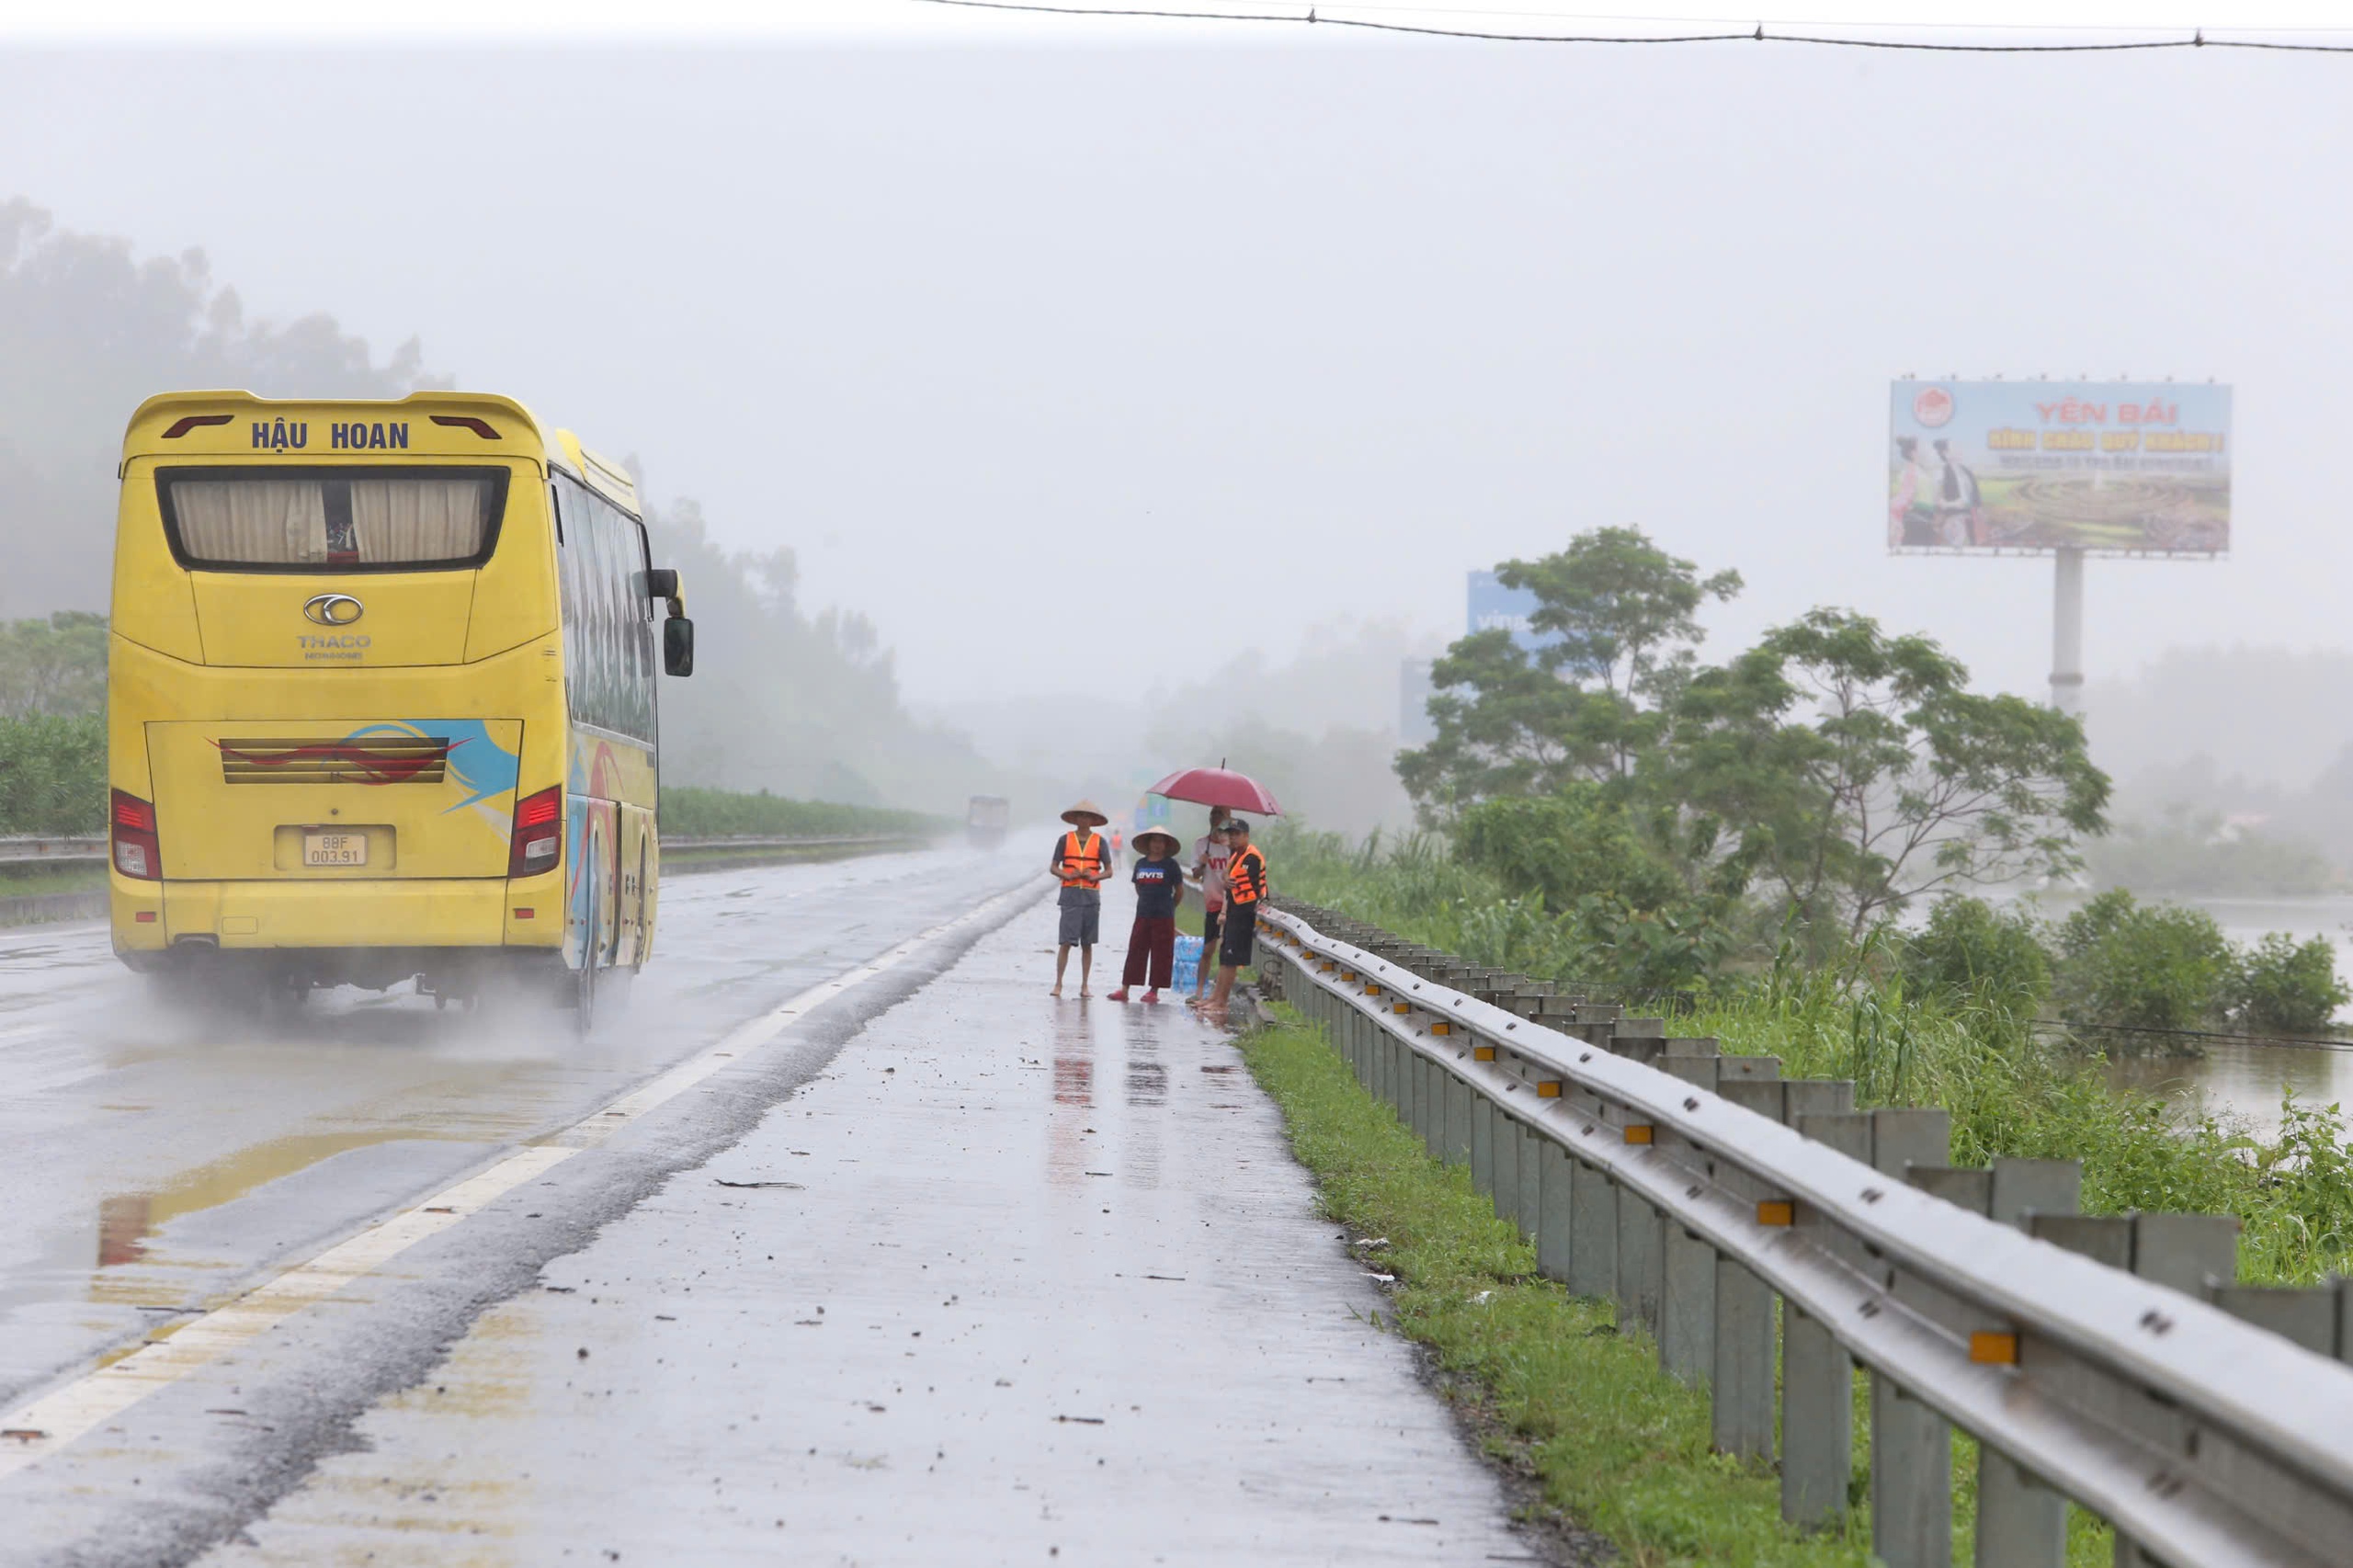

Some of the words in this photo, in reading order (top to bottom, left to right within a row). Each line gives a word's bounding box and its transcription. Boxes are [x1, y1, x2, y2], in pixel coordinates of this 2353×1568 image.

[2034, 395, 2108, 425] YÊN
[252, 416, 307, 453] HẬU
[331, 423, 408, 449] HOAN
[296, 634, 371, 649] THACO
[323, 836, 348, 849] 88F
[312, 850, 358, 863] 003.91
